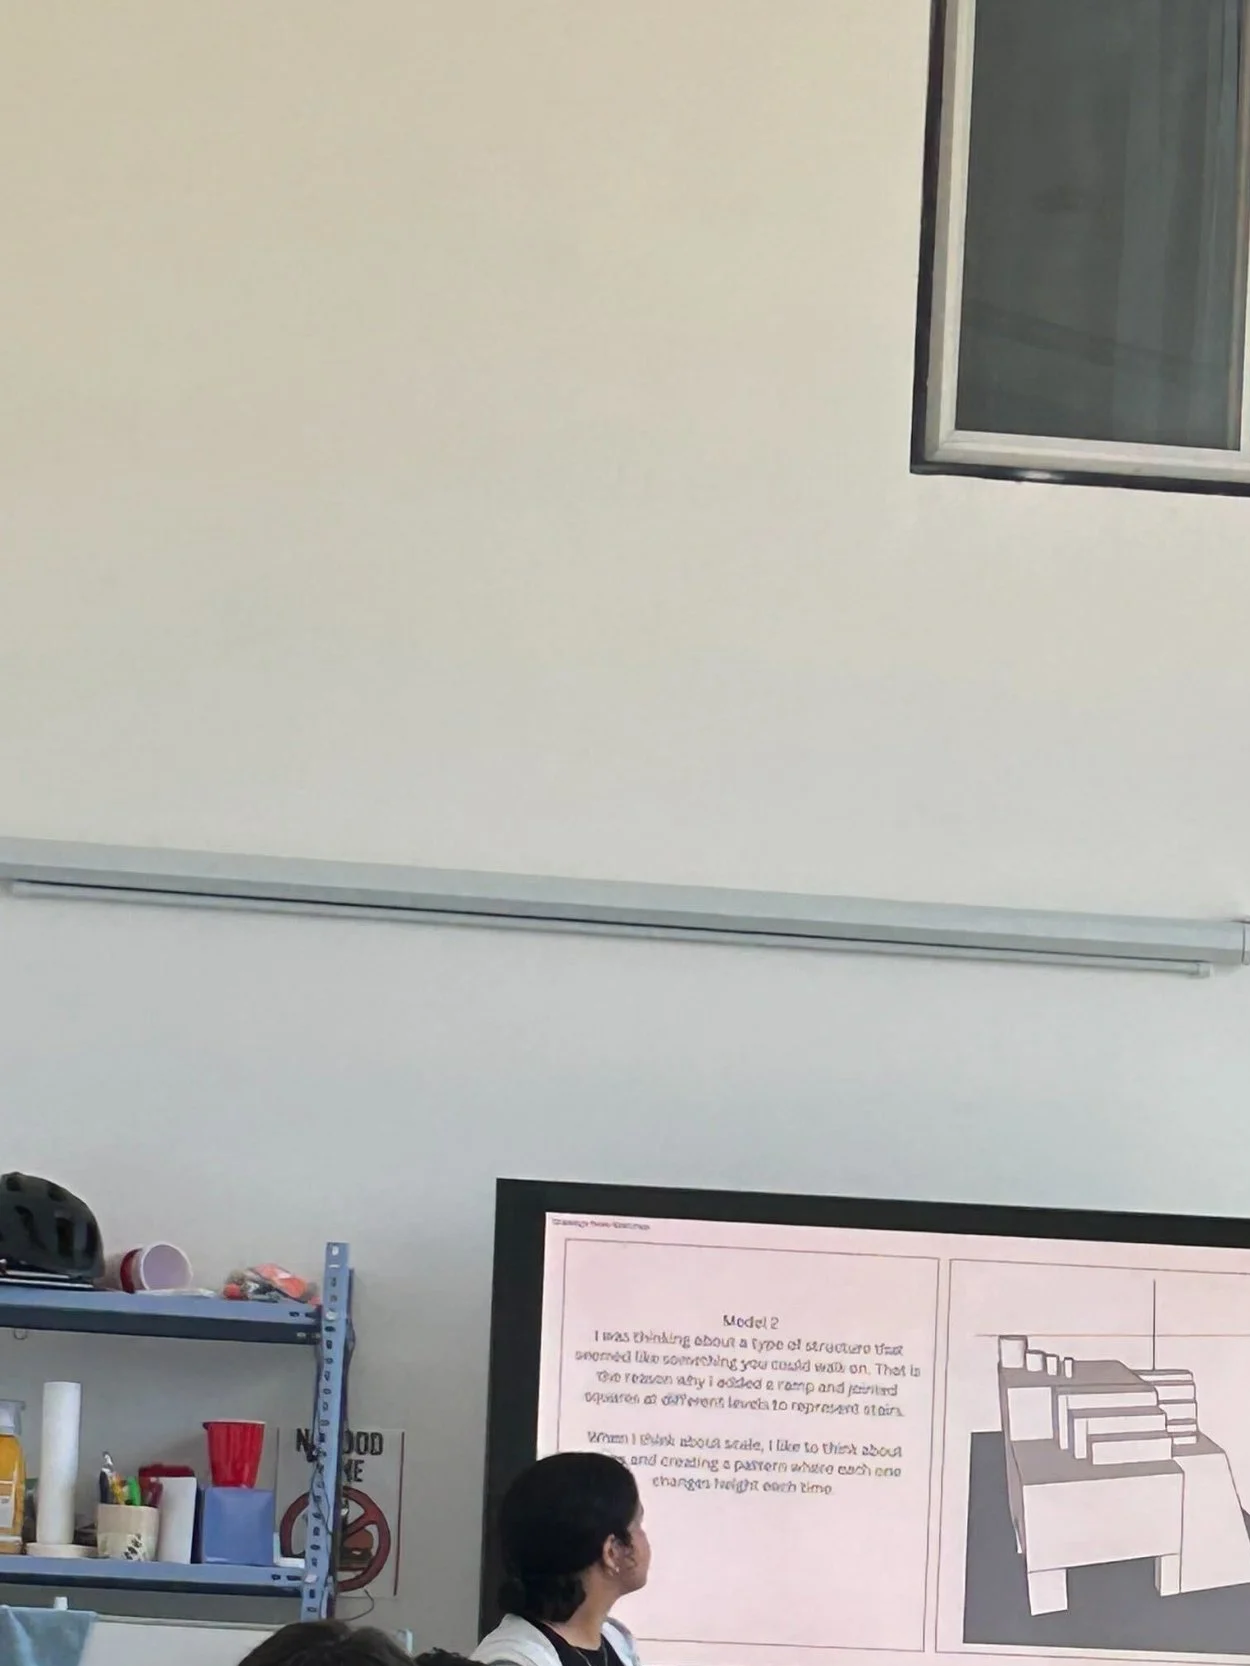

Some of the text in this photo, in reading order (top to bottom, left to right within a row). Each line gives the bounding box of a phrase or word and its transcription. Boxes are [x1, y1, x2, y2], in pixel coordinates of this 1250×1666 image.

[723, 1314, 780, 1330] Model 2
[602, 1331, 630, 1343] was
[633, 1331, 691, 1349] thinking
[694, 1335, 735, 1348] about
[739, 1338, 748, 1348] a
[751, 1337, 784, 1353] type
[787, 1338, 802, 1351] of
[805, 1340, 872, 1355] structure
[874, 1343, 904, 1356] that
[575, 1350, 631, 1363] seemed
[635, 1350, 660, 1365] like
[663, 1354, 738, 1372] something
[740, 1359, 768, 1373] you
[771, 1360, 811, 1373] could
[814, 1361, 846, 1374] walk
[875, 1363, 906, 1377] That
[909, 1364, 921, 1377] is
[596, 1370, 621, 1383] the
[624, 1372, 673, 1385] reason
[676, 1375, 706, 1390] why
[716, 1377, 762, 1389] added
[777, 1380, 815, 1395] ramp
[818, 1381, 845, 1394] and
[584, 1391, 641, 1406] squares
[661, 1393, 725, 1408] different
[728, 1395, 769, 1410] levels
[771, 1399, 788, 1411] to
[791, 1402, 859, 1416] represent
[587, 1431, 629, 1444] When
[639, 1433, 676, 1447] think
[679, 1435, 721, 1449] about
[724, 1437, 765, 1453] scale,
[776, 1438, 801, 1452] like
[804, 1441, 819, 1454] to
[822, 1441, 858, 1455] think
[861, 1443, 903, 1458] about
[630, 1453, 657, 1466] and
[660, 1456, 719, 1472] creating
[734, 1459, 788, 1474] pattern
[791, 1461, 834, 1475] where
[837, 1463, 871, 1477] each
[874, 1466, 902, 1478] one
[652, 1475, 711, 1491] changes
[714, 1477, 759, 1494] height
[762, 1480, 797, 1493] each
